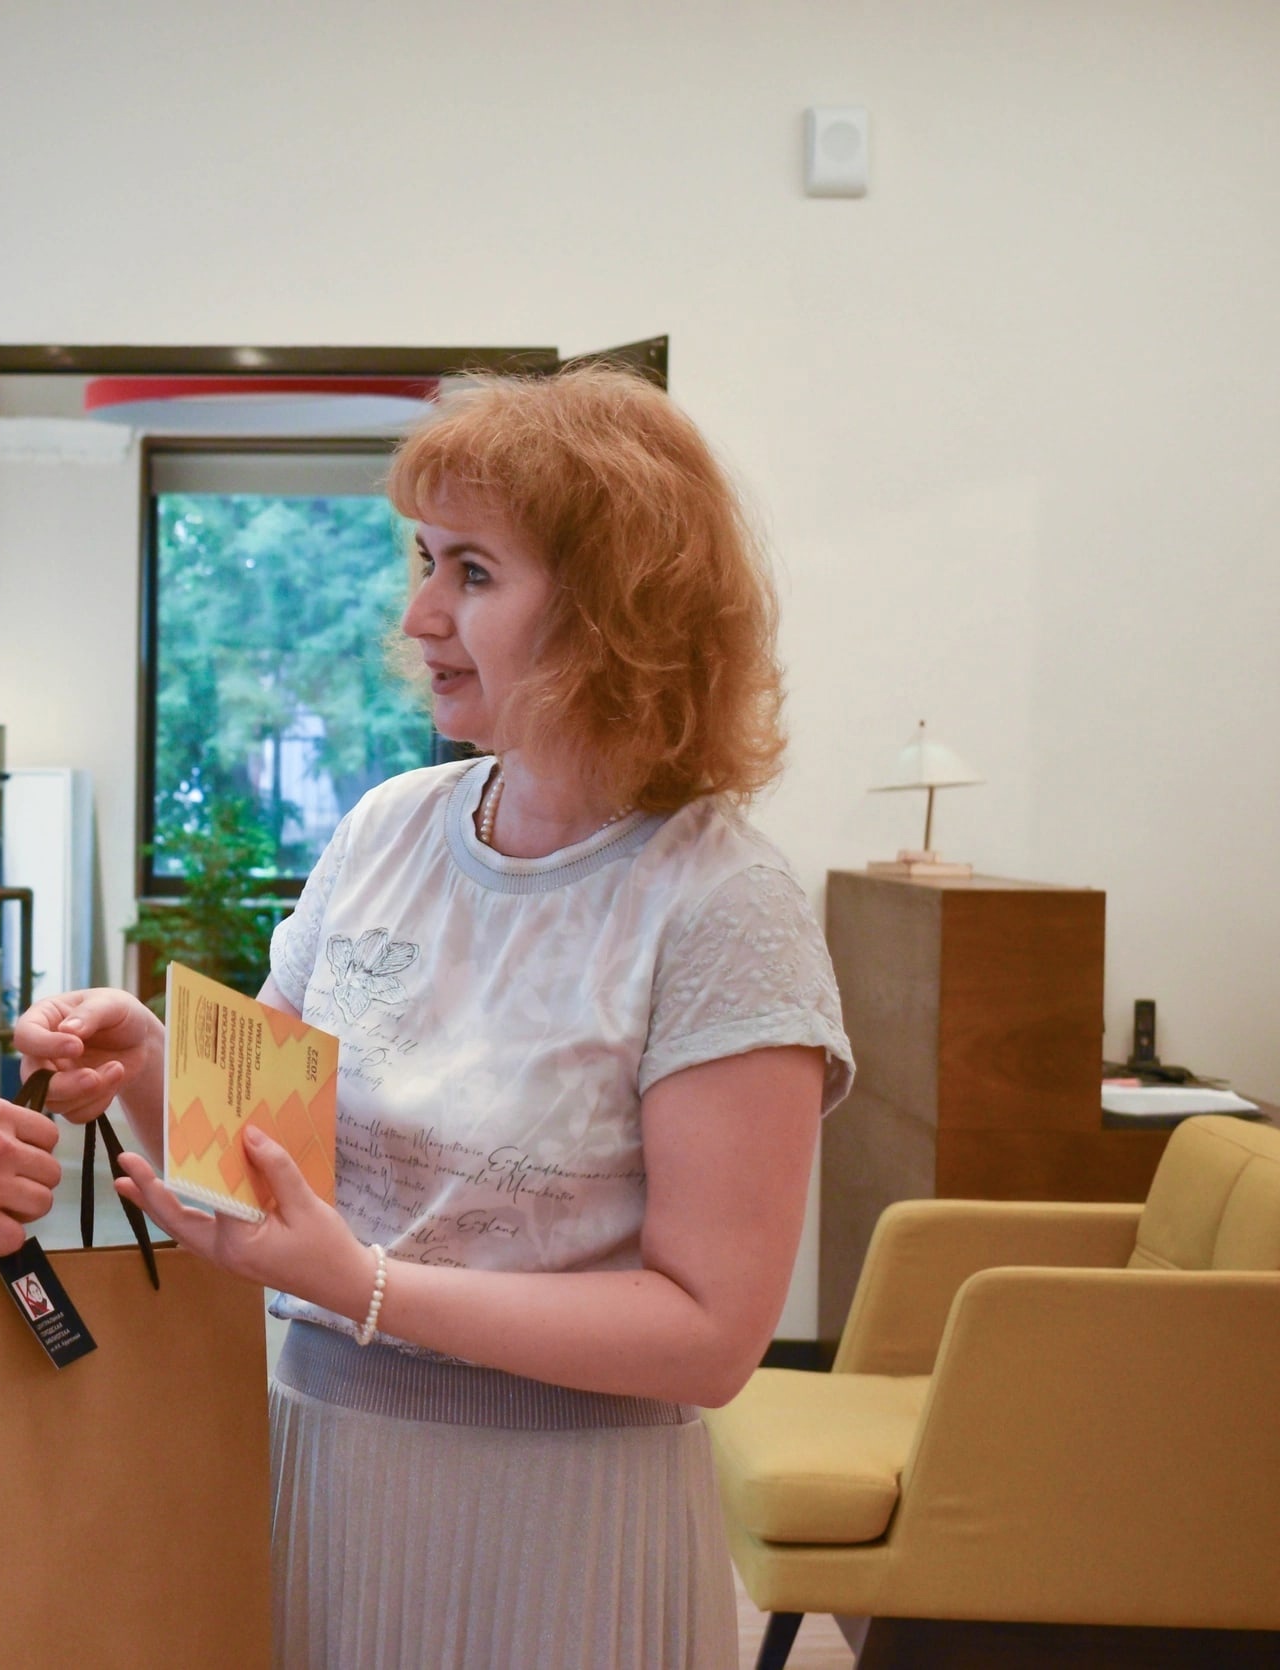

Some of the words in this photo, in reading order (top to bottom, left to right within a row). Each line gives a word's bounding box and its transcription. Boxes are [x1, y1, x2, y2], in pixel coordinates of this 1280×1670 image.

[219, 1006, 229, 1070] САМАРСКАЯ
[227, 1009, 237, 1107] МУНИЦИПАЛЬНАЯ
[235, 1015, 245, 1118] ИНФОРМАЦИОННО-
[246, 1018, 255, 1101] БИБЛИОТЕЧНАЯ
[255, 1021, 263, 1071] СИСТЕМА
[310, 1048, 320, 1083] 2022
[455, 1209, 520, 1238] England
